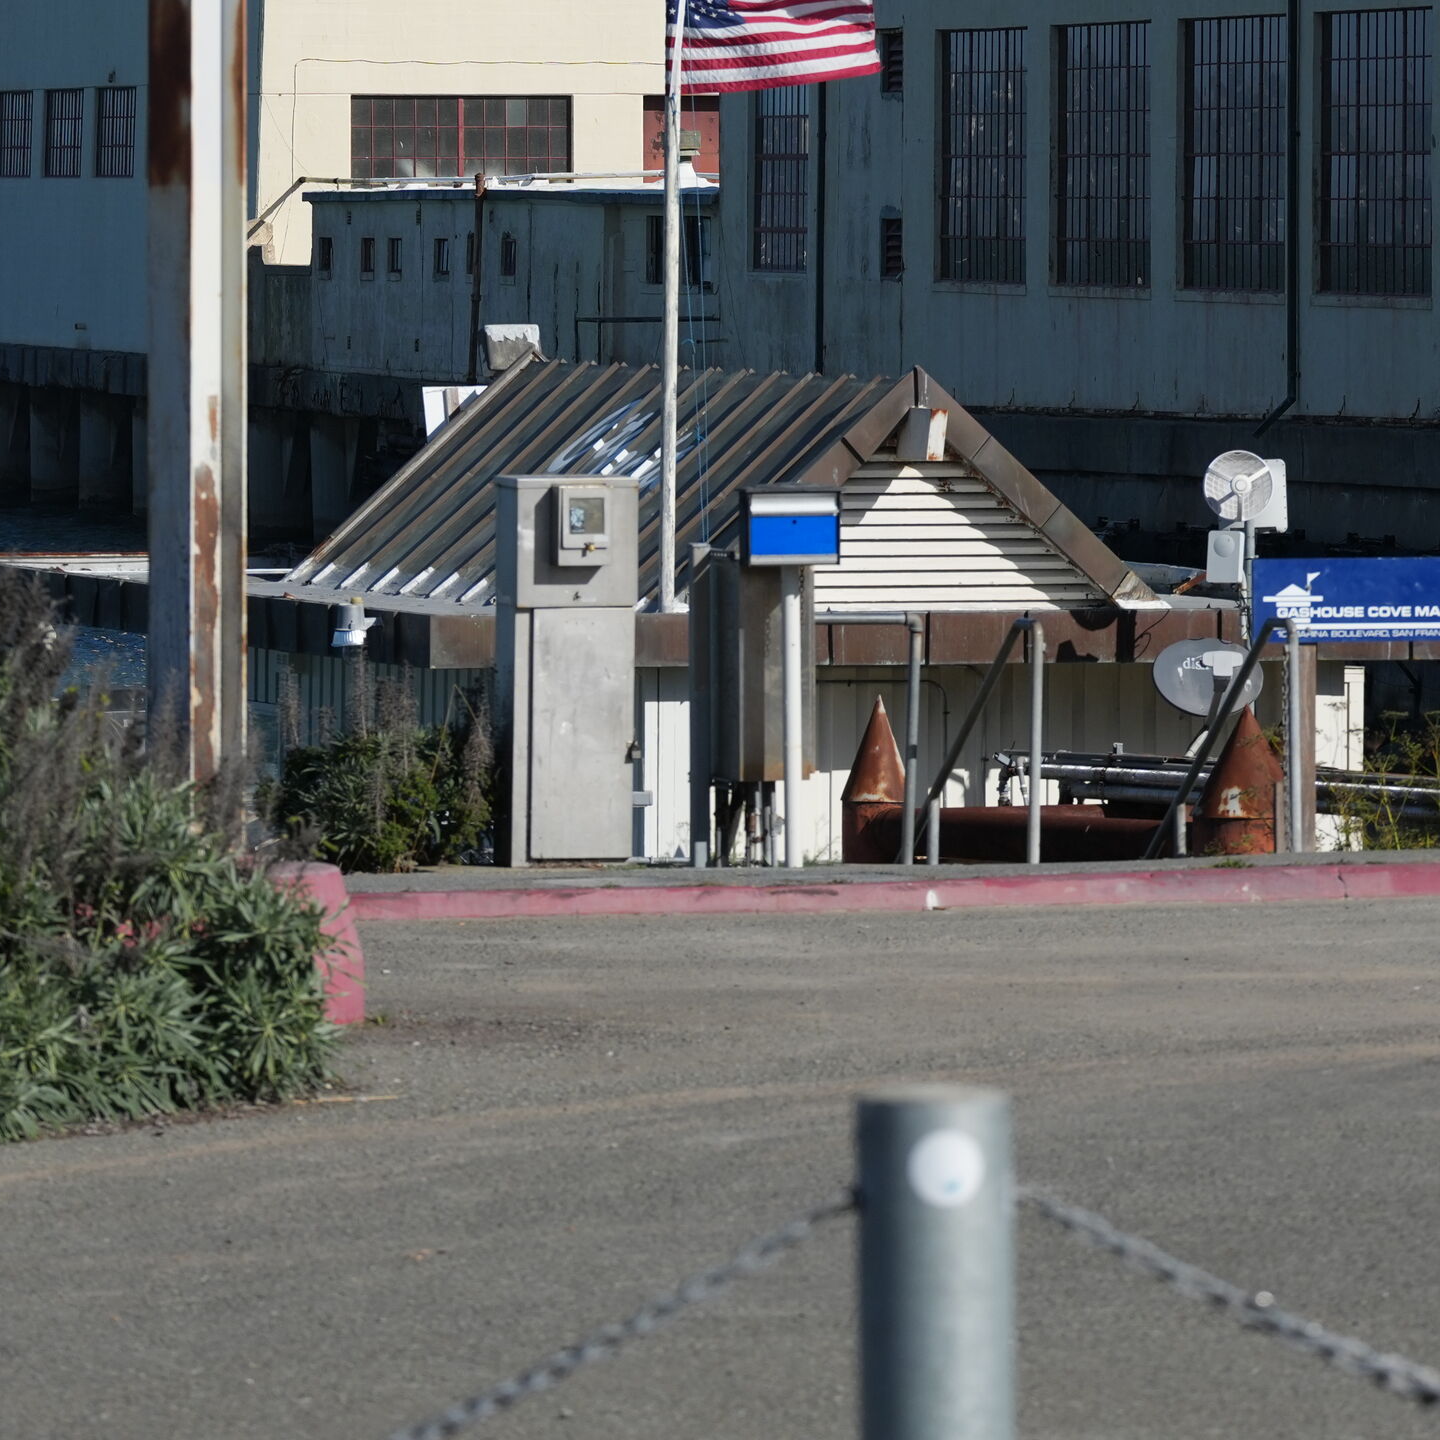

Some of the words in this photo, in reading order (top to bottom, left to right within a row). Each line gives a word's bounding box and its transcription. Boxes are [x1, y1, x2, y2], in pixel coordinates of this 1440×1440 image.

[1276, 606, 1364, 619] GASHOUSE
[1367, 605, 1412, 618] COVE
[1391, 629, 1414, 637] SAN
[1182, 657, 1210, 670] dis
